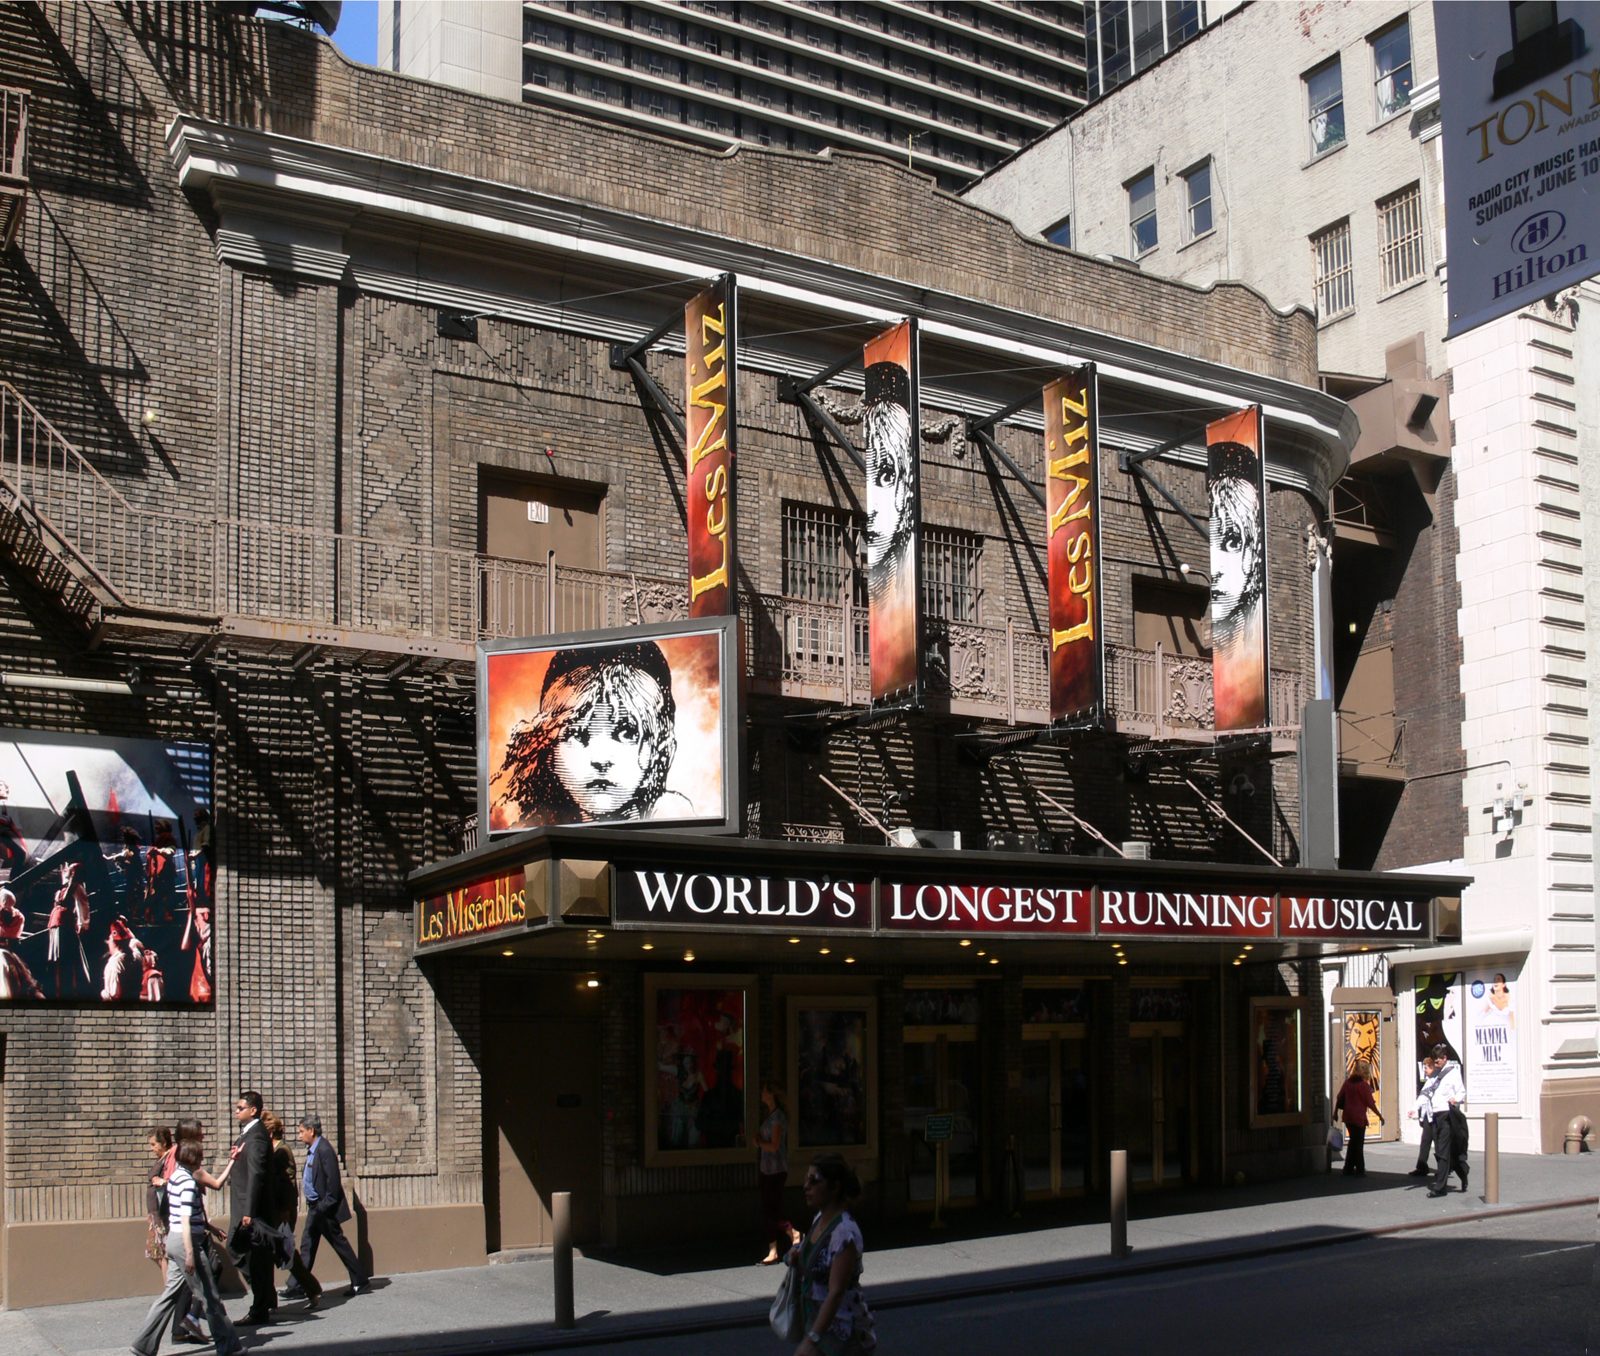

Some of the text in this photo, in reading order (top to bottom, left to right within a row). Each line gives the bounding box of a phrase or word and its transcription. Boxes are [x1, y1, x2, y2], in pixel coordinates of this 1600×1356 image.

[1468, 137, 1600, 211] RADIO CITY MUSIC HA
[1476, 156, 1600, 226] SUNDAY, JUNE 10
[1492, 243, 1589, 300] Hilton
[530, 501, 547, 521] EXIT
[420, 876, 526, 942] Les Misérables
[635, 870, 1422, 931] WORLD'S LONGEST RUNNING MUSICAL
[1475, 1028, 1508, 1045] MAMMA
[1482, 1045, 1501, 1062] MIA!
